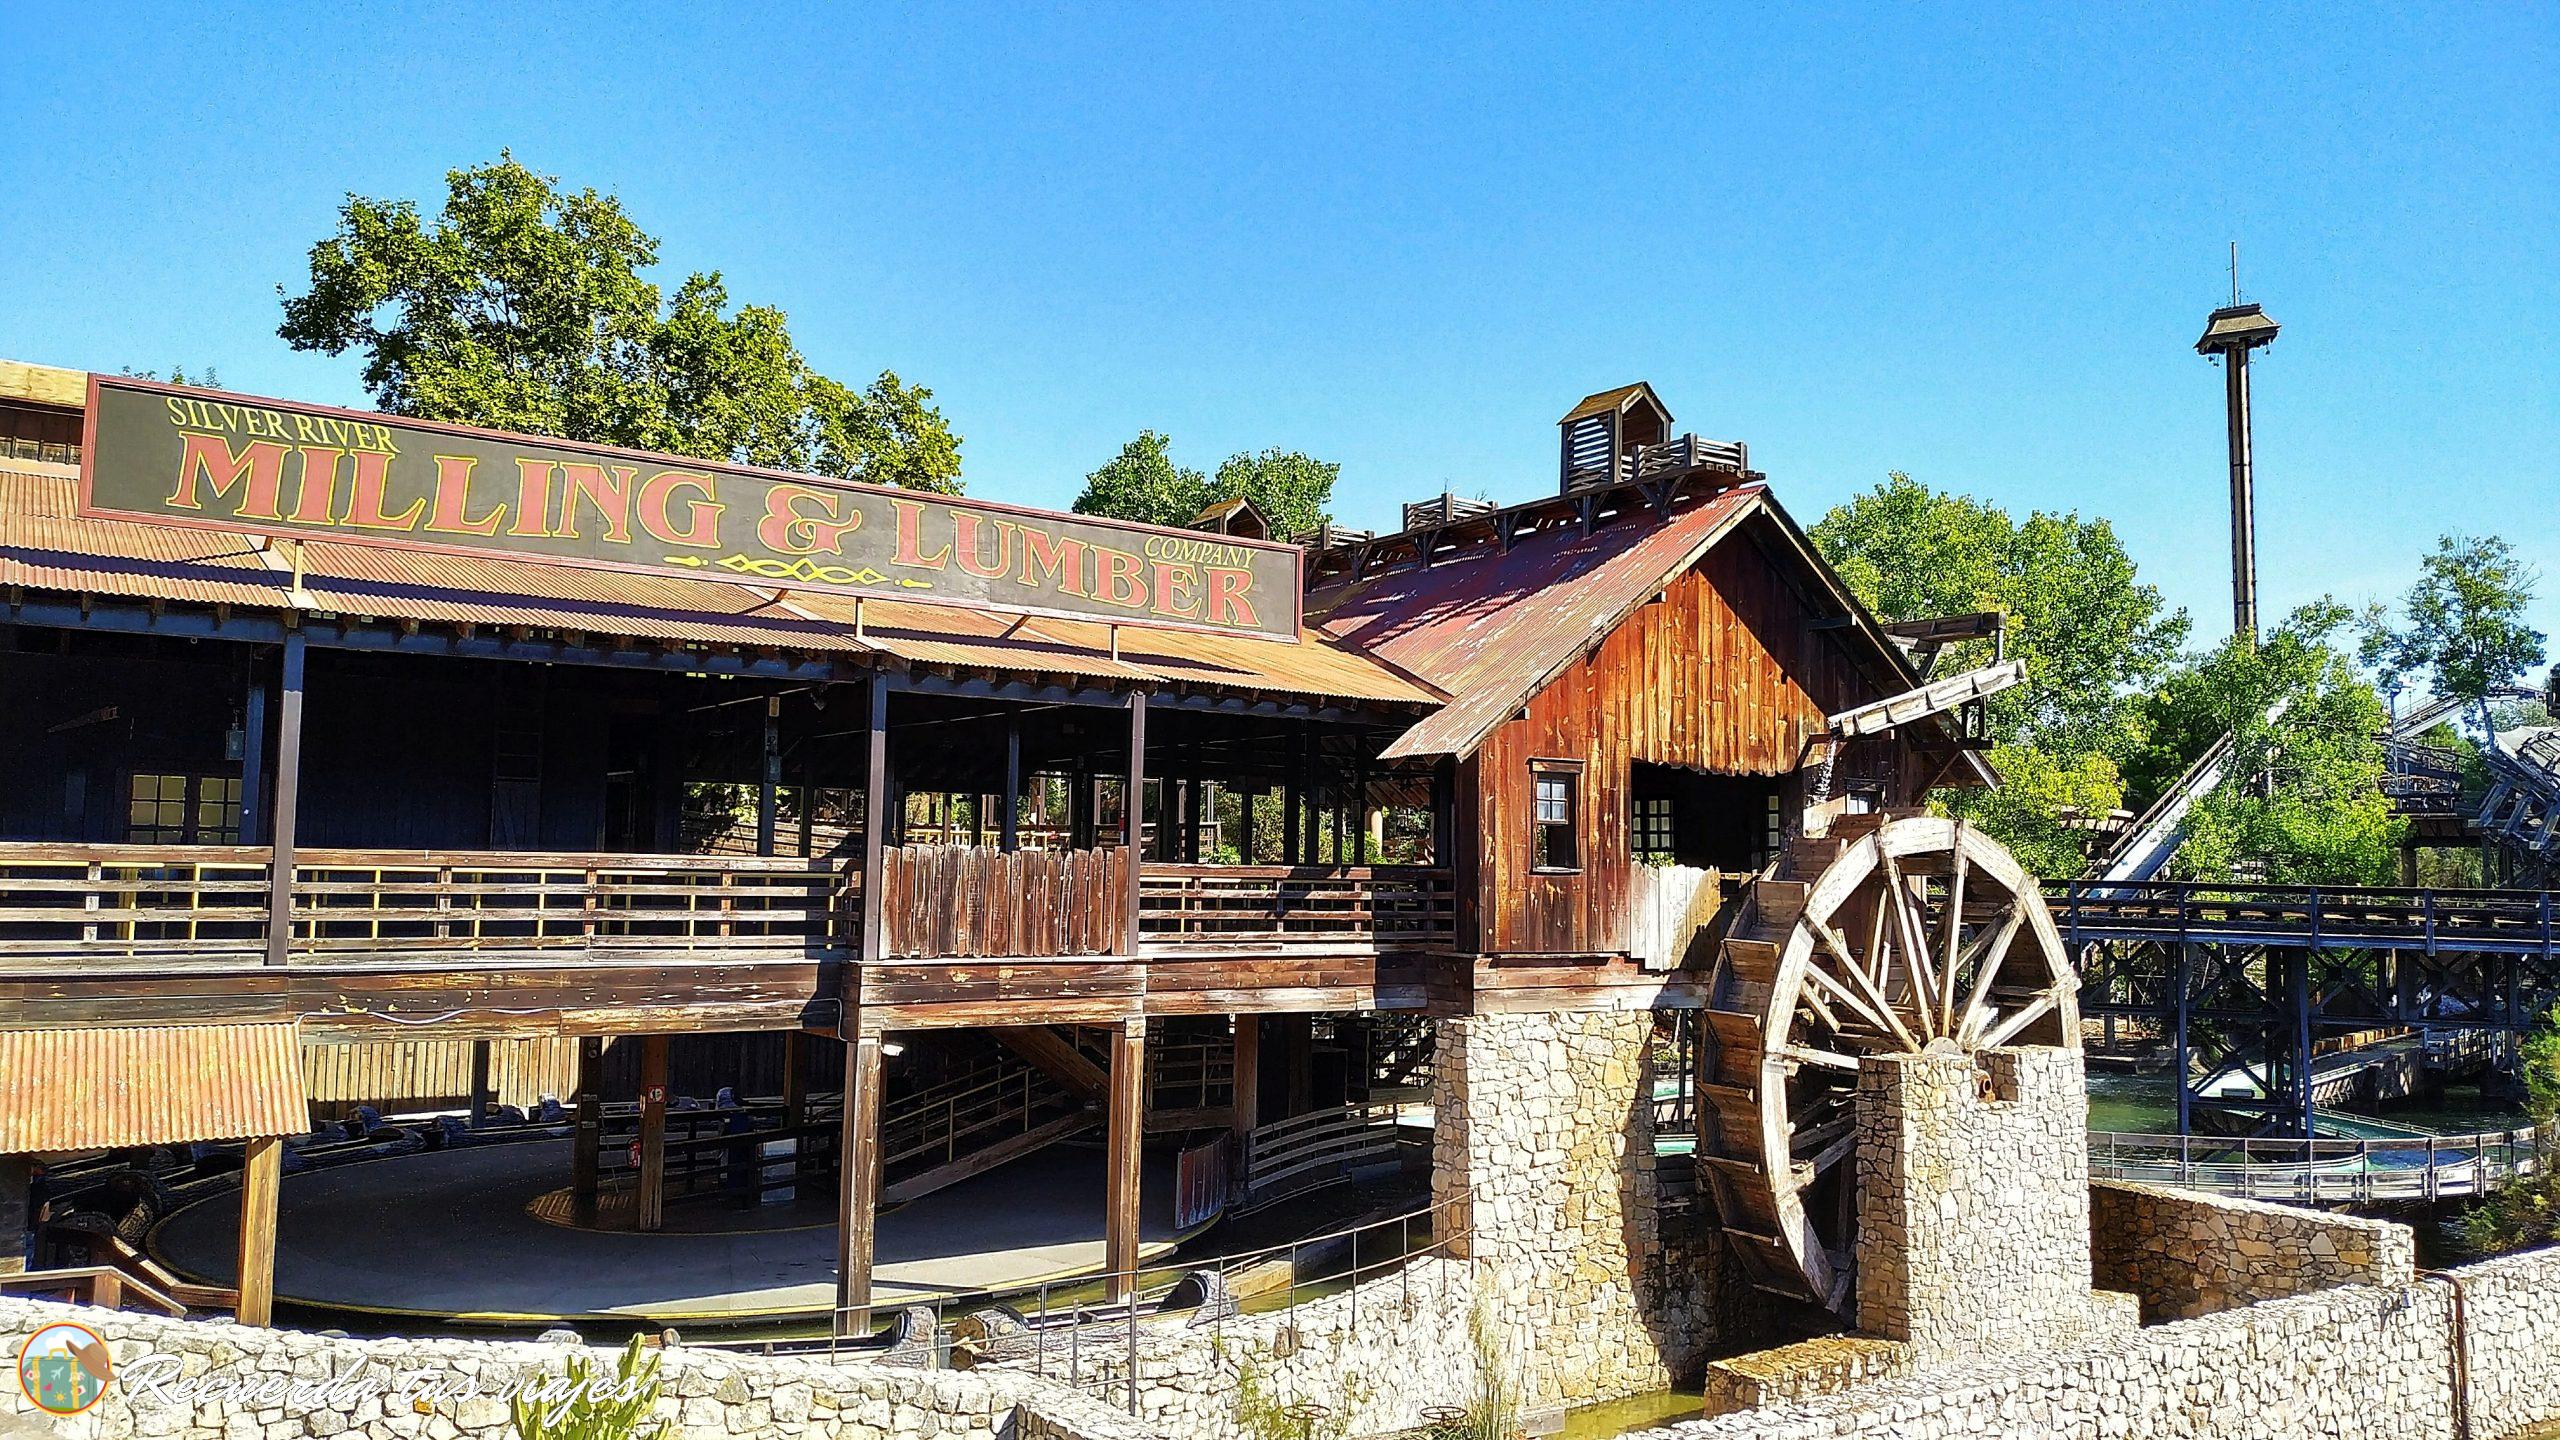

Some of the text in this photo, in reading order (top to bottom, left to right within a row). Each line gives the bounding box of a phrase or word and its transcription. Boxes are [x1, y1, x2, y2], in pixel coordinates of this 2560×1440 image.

[166, 397, 401, 453] SILVER RIVER
[165, 431, 1262, 628] MILLING & LUMBER
[1144, 535, 1257, 568] COMPANY
